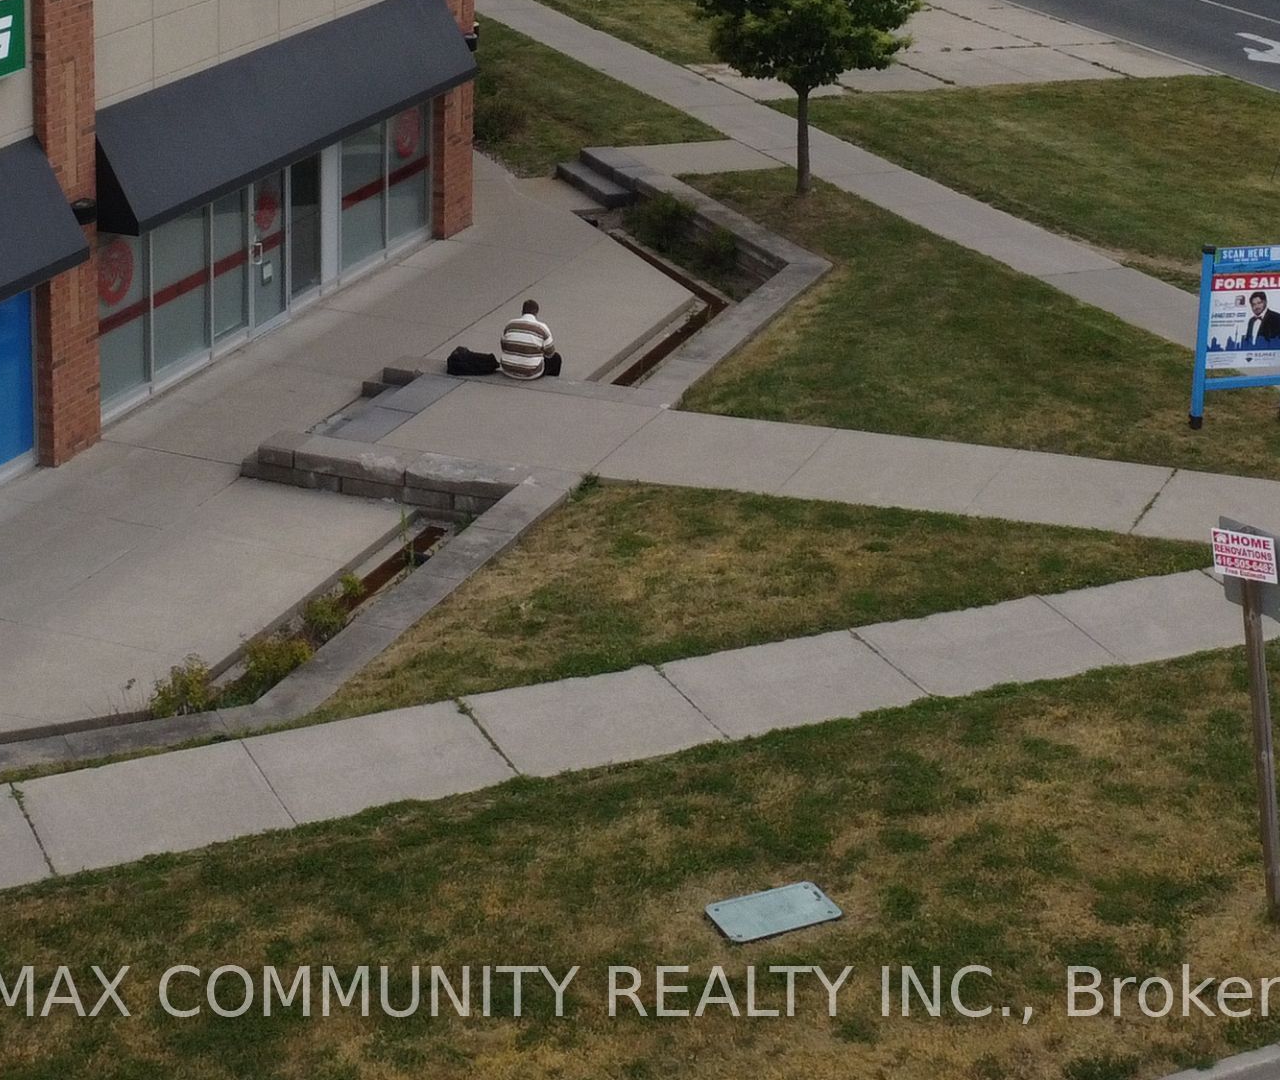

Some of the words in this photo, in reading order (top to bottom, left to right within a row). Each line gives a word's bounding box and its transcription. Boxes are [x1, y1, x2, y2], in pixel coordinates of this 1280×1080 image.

[1222, 249, 1245, 260] SCAN
[1248, 247, 1269, 258] HERE
[1214, 277, 1246, 290] FOR
[1230, 534, 1272, 551] HOME
[1214, 543, 1273, 561] RENOVATIONS
